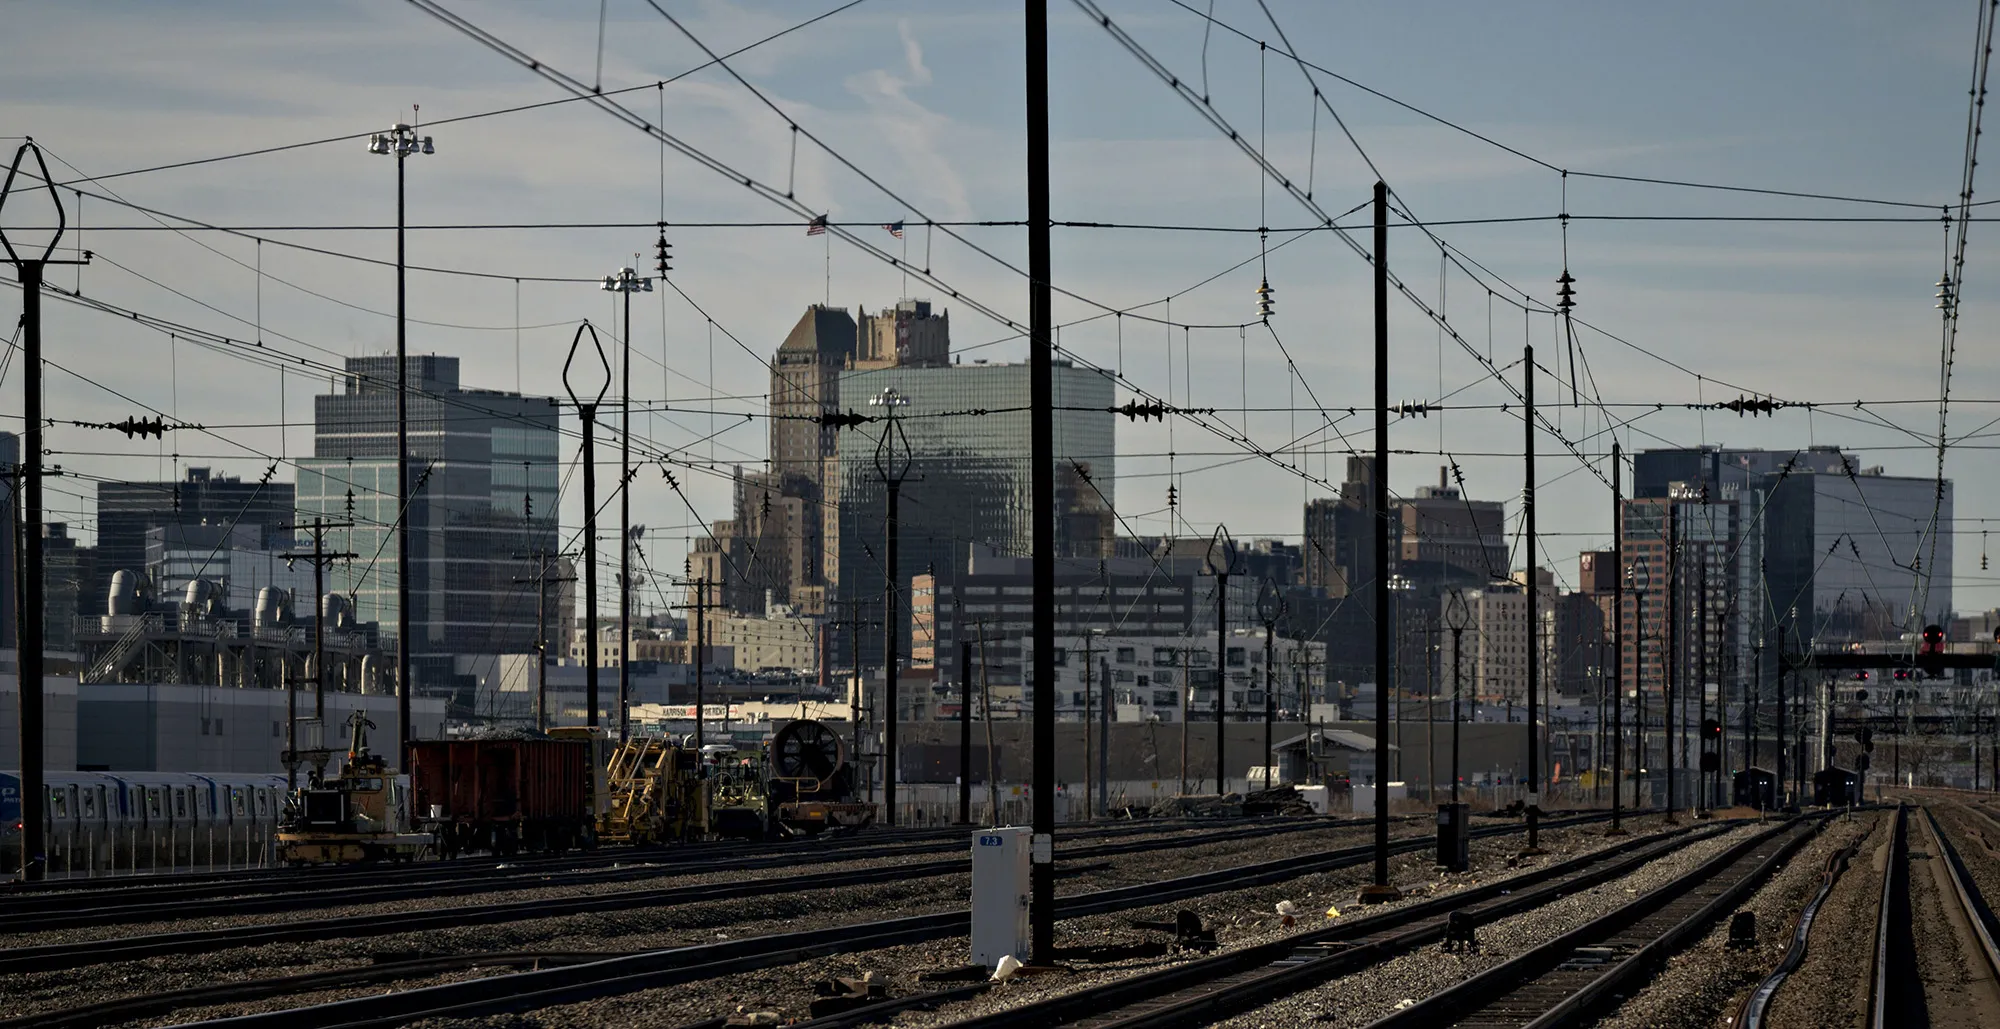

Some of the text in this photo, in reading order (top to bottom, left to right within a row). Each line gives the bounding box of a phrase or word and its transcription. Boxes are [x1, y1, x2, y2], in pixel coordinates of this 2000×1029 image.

[662, 707, 686, 716] HARRISON
[712, 707, 725, 716] RENT
[985, 837, 998, 845] 7.3
